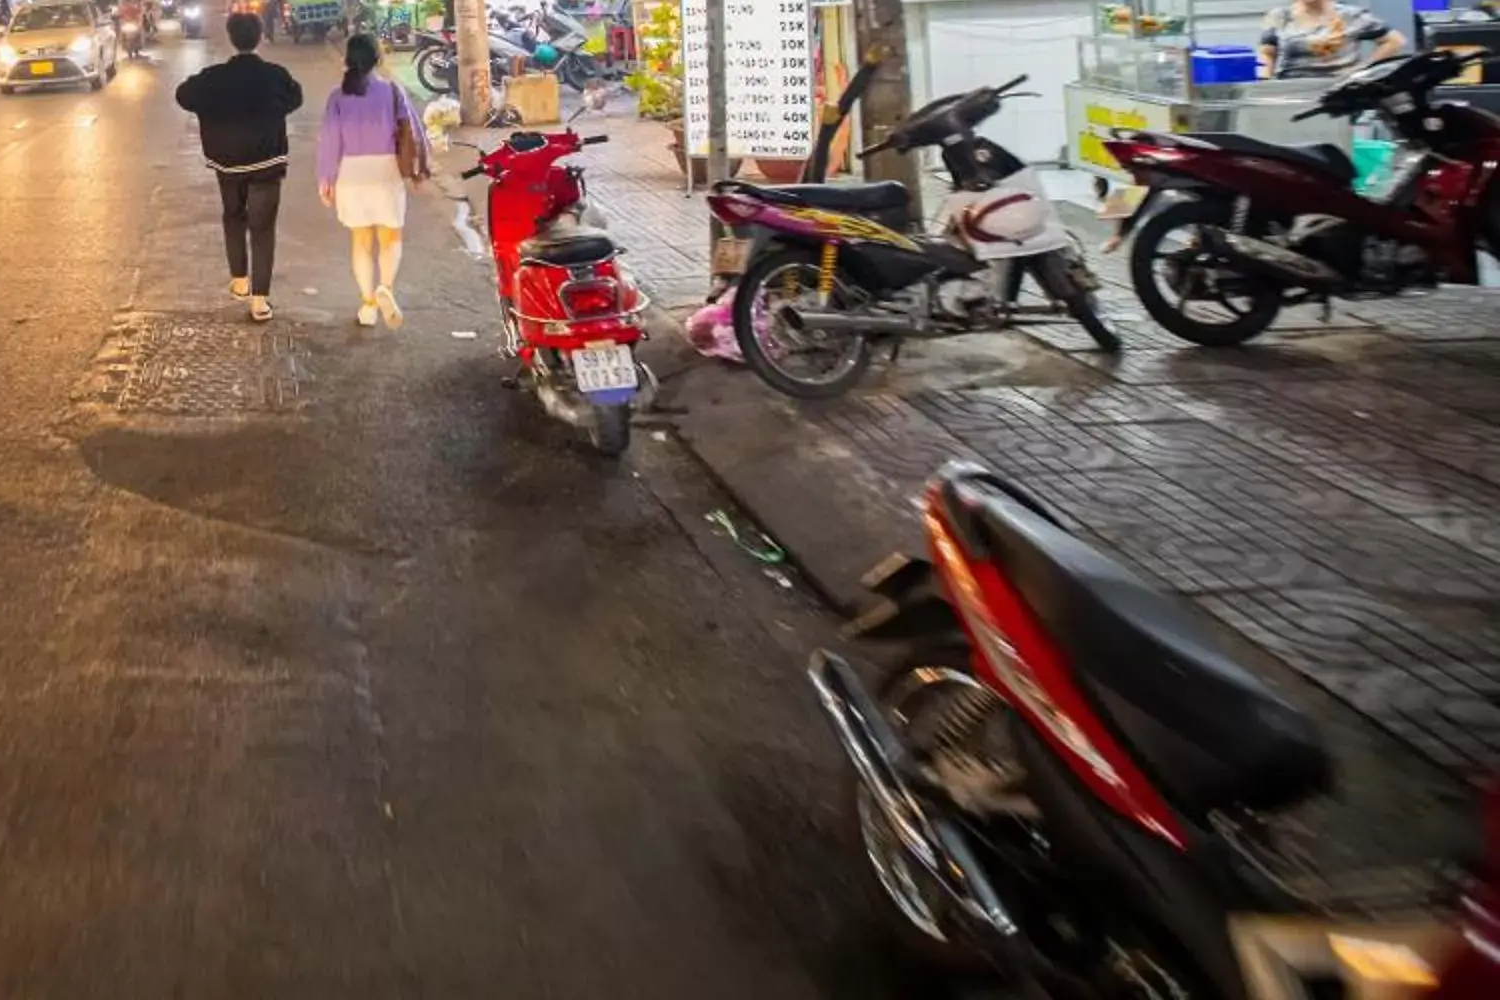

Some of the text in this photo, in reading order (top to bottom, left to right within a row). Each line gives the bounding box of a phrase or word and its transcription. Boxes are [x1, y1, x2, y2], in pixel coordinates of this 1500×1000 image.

[779, 3, 805, 13] 25K
[779, 21, 805, 32] 25K
[780, 39, 806, 50] 30K
[781, 58, 807, 69] 30K
[782, 76, 807, 87] 30K
[782, 94, 808, 105] 35K
[783, 112, 809, 123] 40K
[783, 131, 810, 142] 40K
